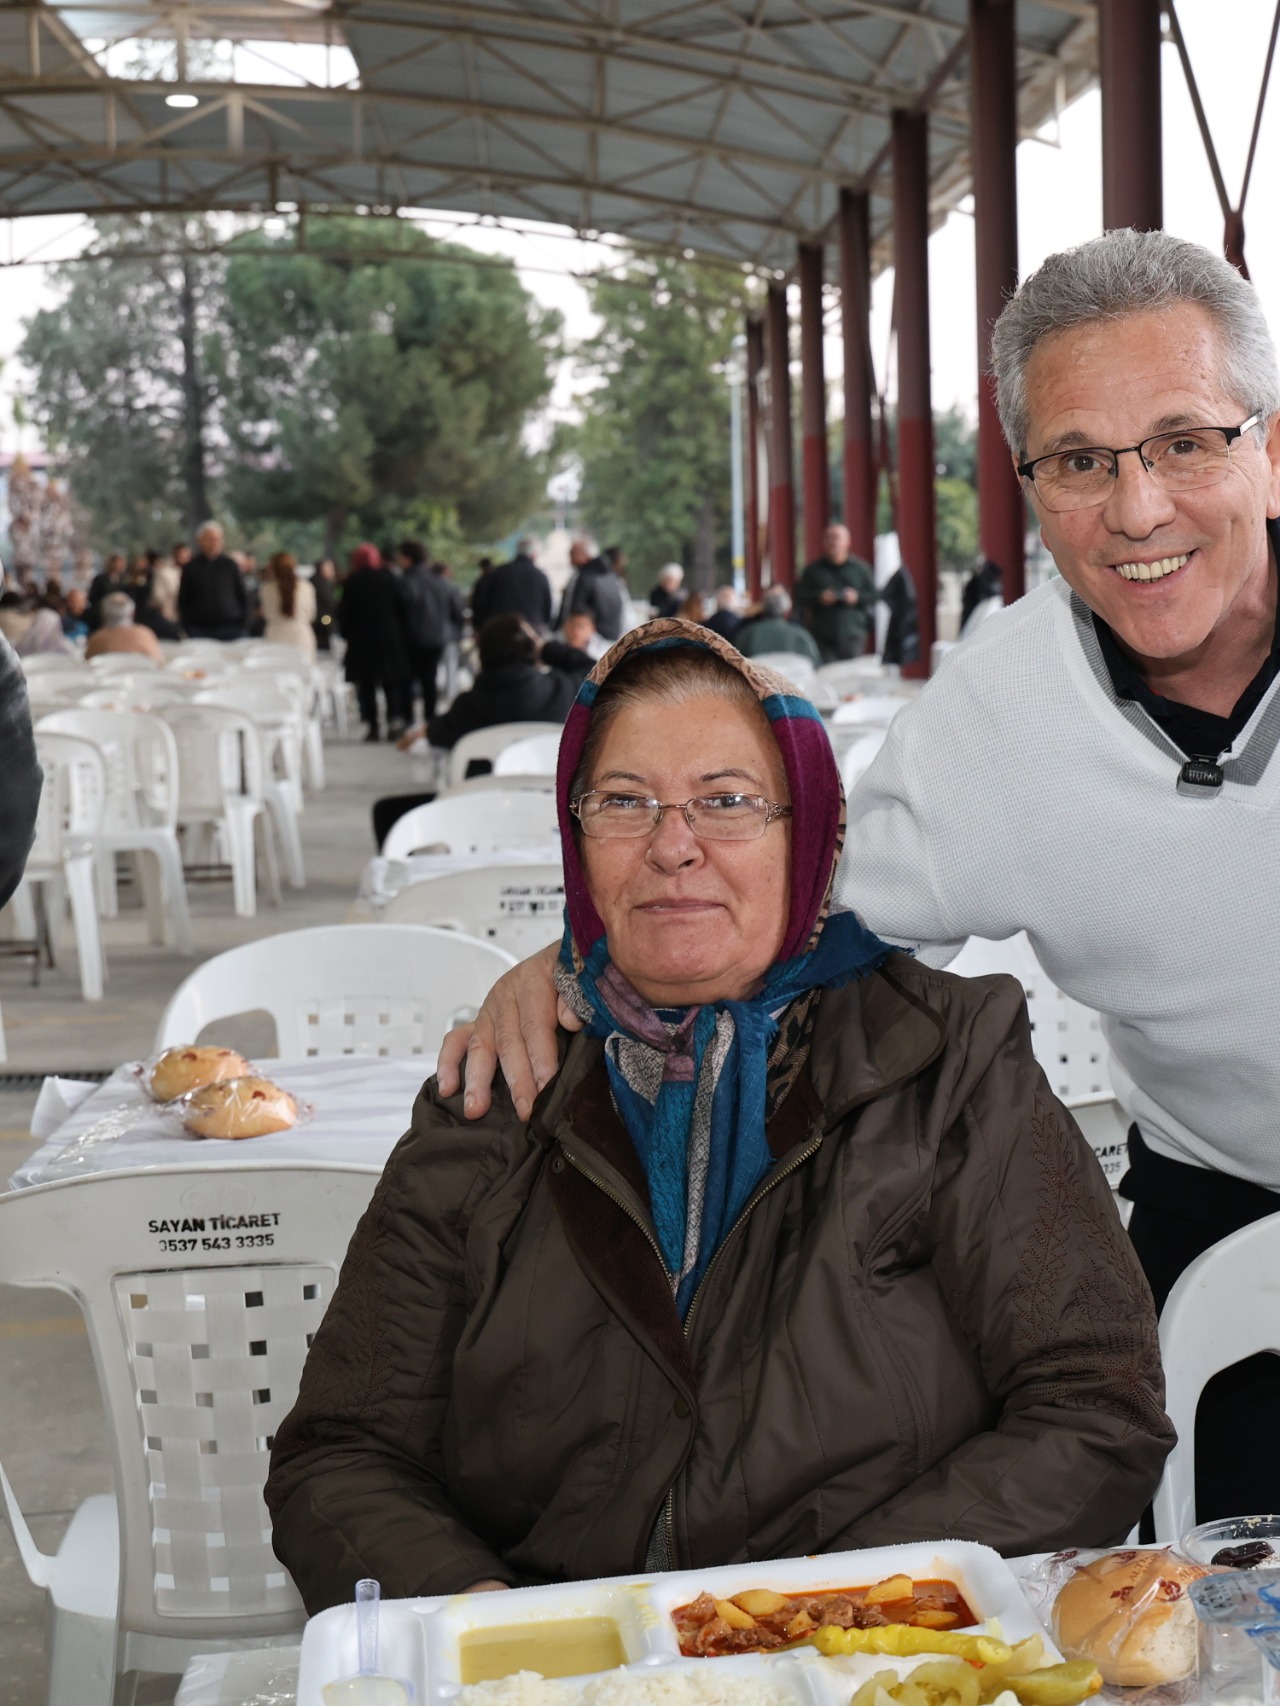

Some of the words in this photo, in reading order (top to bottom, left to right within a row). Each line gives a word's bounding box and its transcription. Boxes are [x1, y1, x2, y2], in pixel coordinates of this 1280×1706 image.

[148, 1218, 206, 1233] SAYAN
[209, 1213, 281, 1231] TİCARET
[159, 1239, 198, 1252] 0537
[202, 1237, 231, 1251] 543
[235, 1234, 275, 1249] 3335
